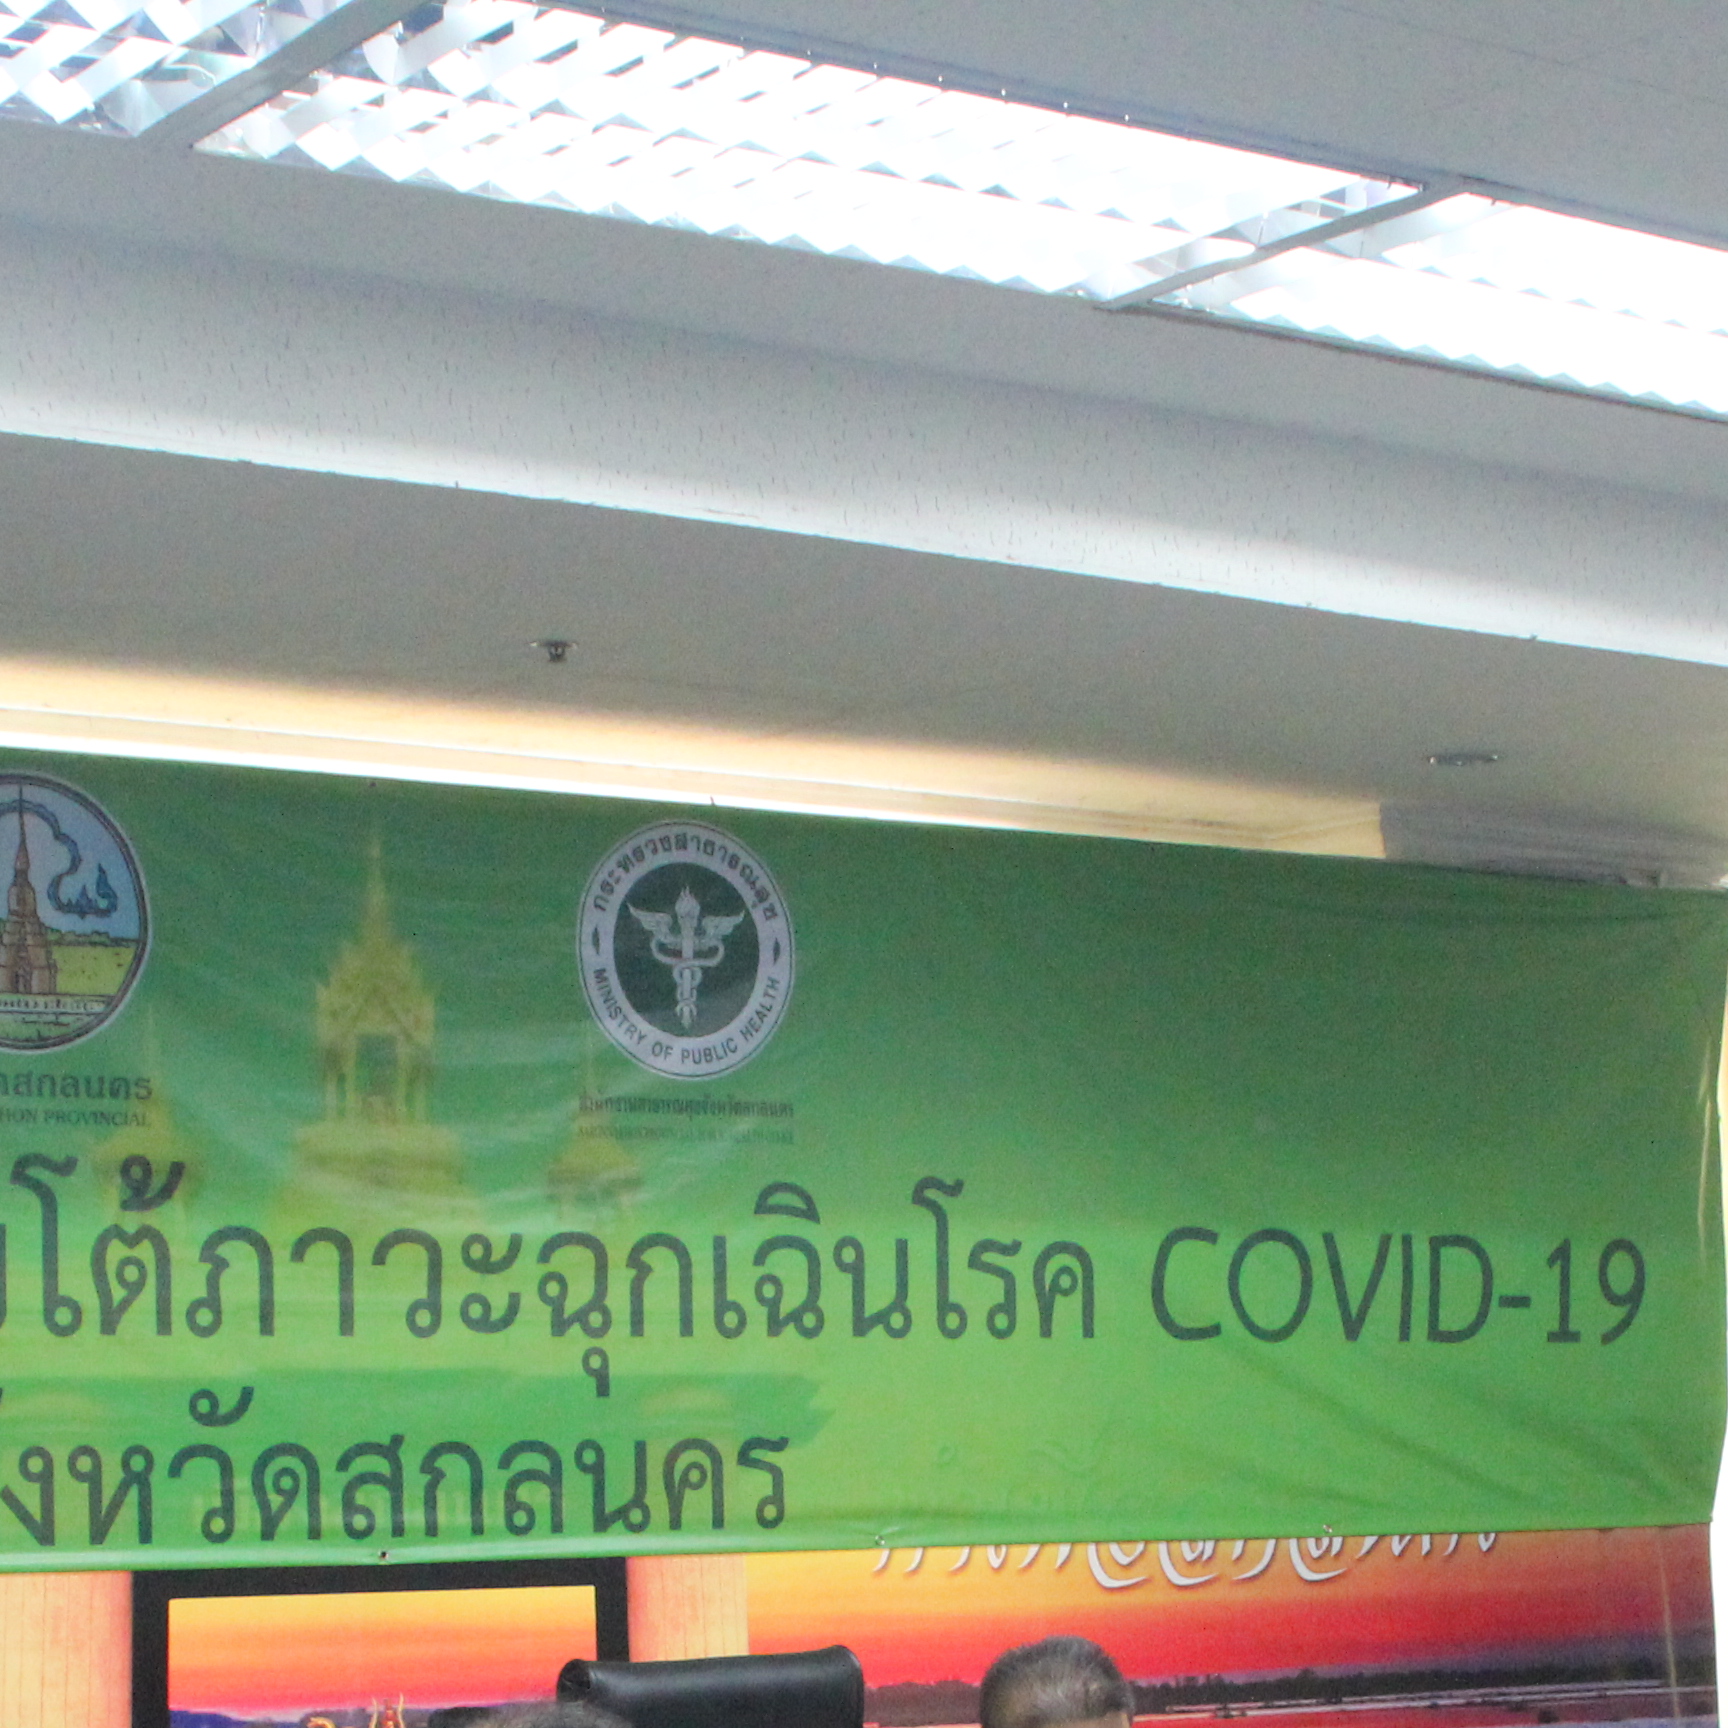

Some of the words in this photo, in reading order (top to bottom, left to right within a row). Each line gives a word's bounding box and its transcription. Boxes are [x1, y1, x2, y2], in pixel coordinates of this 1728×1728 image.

[593, 967, 648, 1046] MINISTRY
[651, 1041, 674, 1061] OF
[681, 1037, 738, 1064] PUBLIC
[739, 976, 780, 1043] HEALTH
[42, 1109, 151, 1128] PROVINCIAL
[1148, 1226, 1648, 1347] COVID-19
